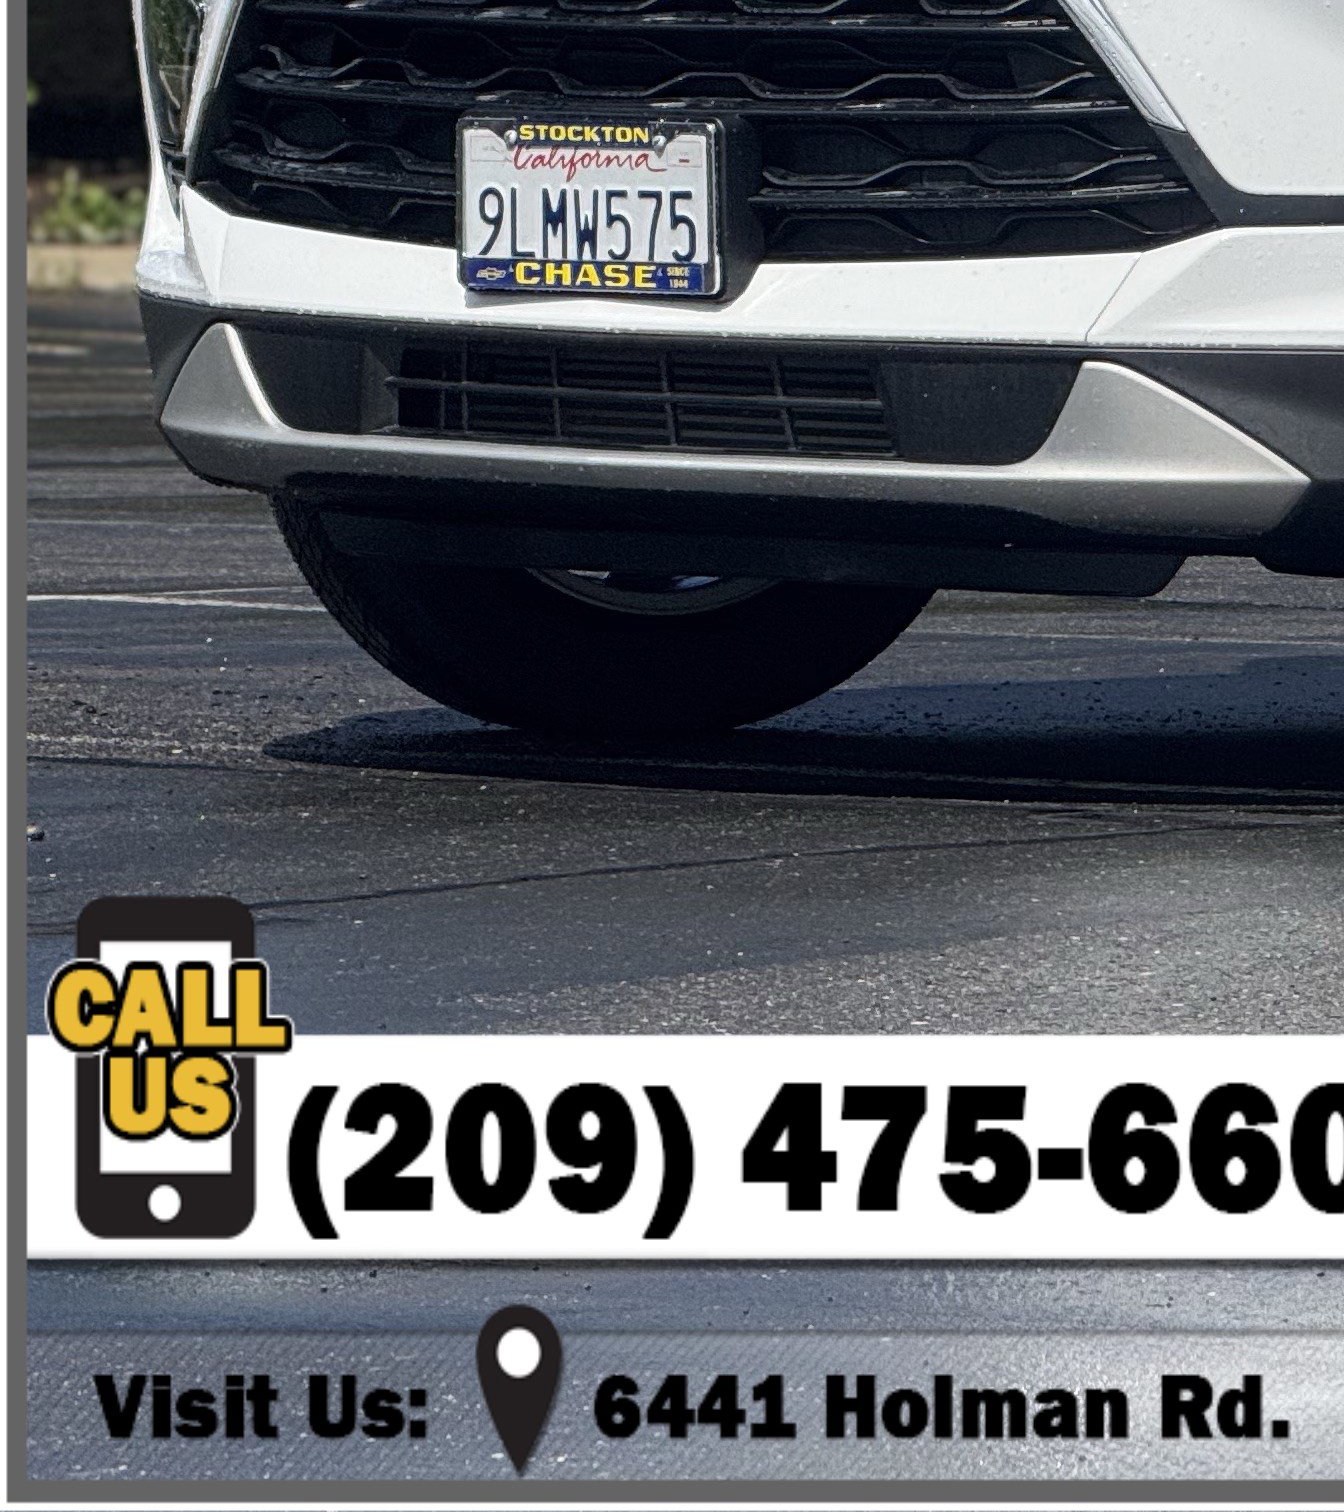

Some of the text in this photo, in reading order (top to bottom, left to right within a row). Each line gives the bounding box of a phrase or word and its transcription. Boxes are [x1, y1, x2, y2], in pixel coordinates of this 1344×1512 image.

[519, 124, 649, 144] STOCKTON
[513, 144, 667, 182] California
[478, 187, 697, 261] 9LMW575
[515, 262, 657, 288] CHASE
